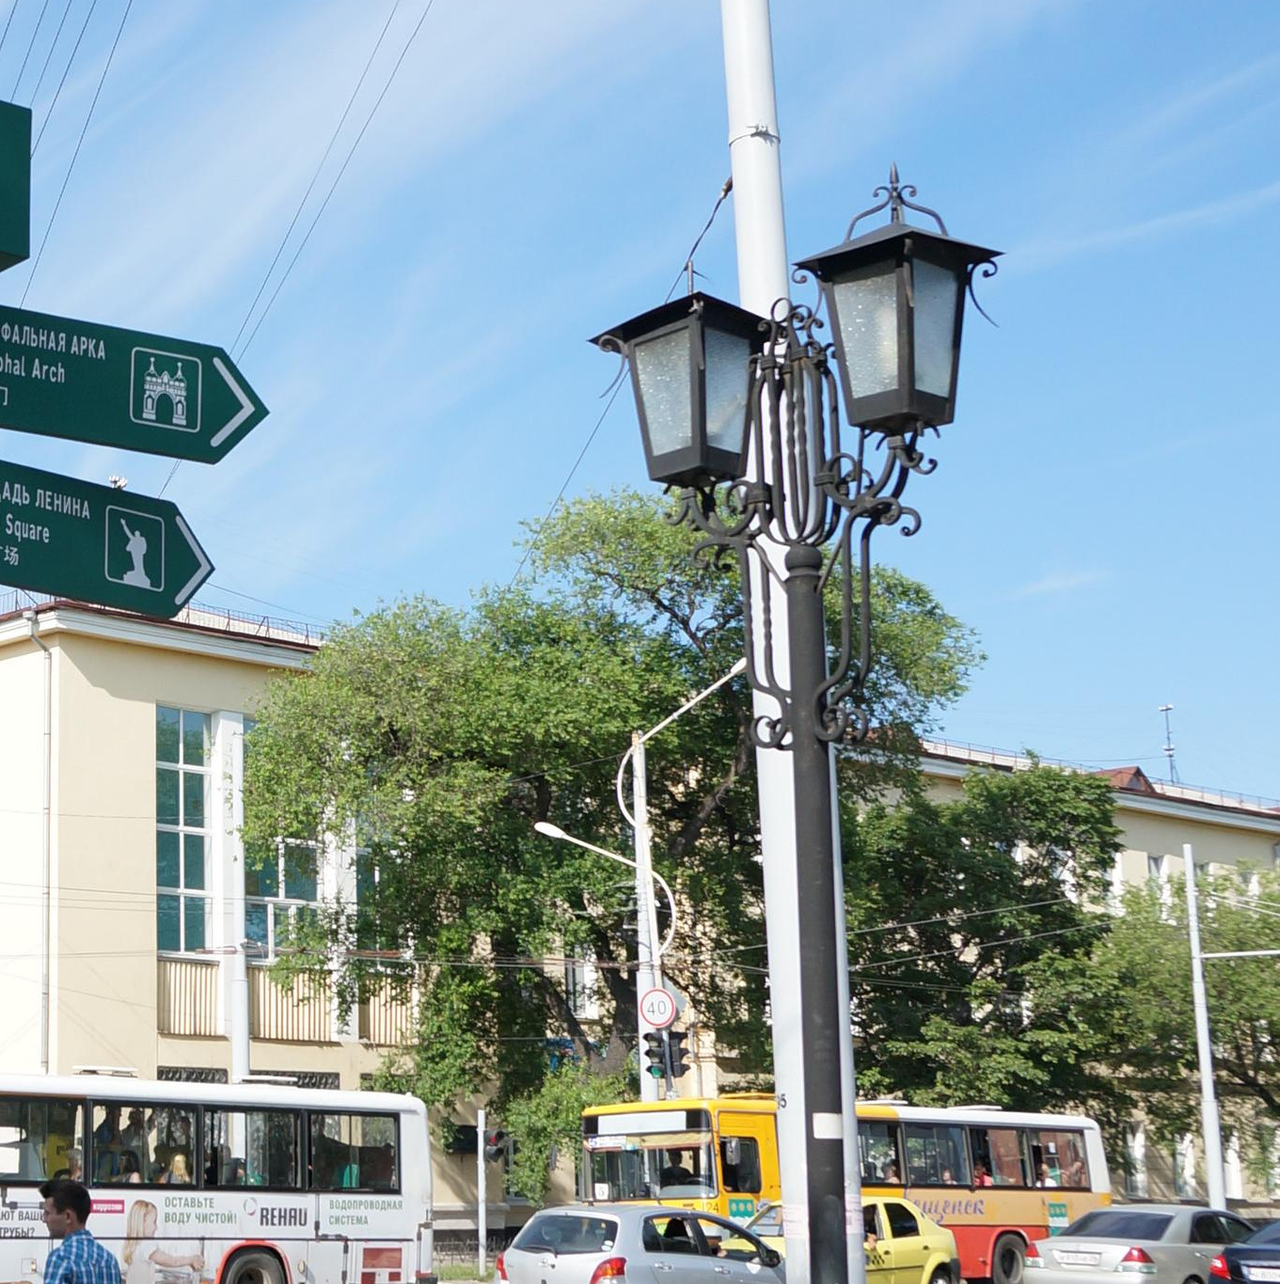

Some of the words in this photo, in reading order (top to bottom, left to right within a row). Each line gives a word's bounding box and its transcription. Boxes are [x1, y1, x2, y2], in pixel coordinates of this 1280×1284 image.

[70, 337, 106, 360] АРКА
[31, 358, 65, 384] Arch
[35, 488, 90, 519] ЛЕНИНА
[5, 514, 50, 543] Square
[647, 1000, 667, 1016] 40
[164, 1196, 214, 1208] ОСТАВЬТЕ
[329, 1199, 403, 1211] ВОДОПРОВОДНАЯ
[164, 1213, 191, 1225] ВОДУ
[195, 1210, 237, 1224] ЧИСТОЙ!
[260, 1206, 307, 1226] REHAU
[329, 1214, 369, 1225] СИСТЕМА
[0, 1227, 35, 1238] ТРУБЫ?
